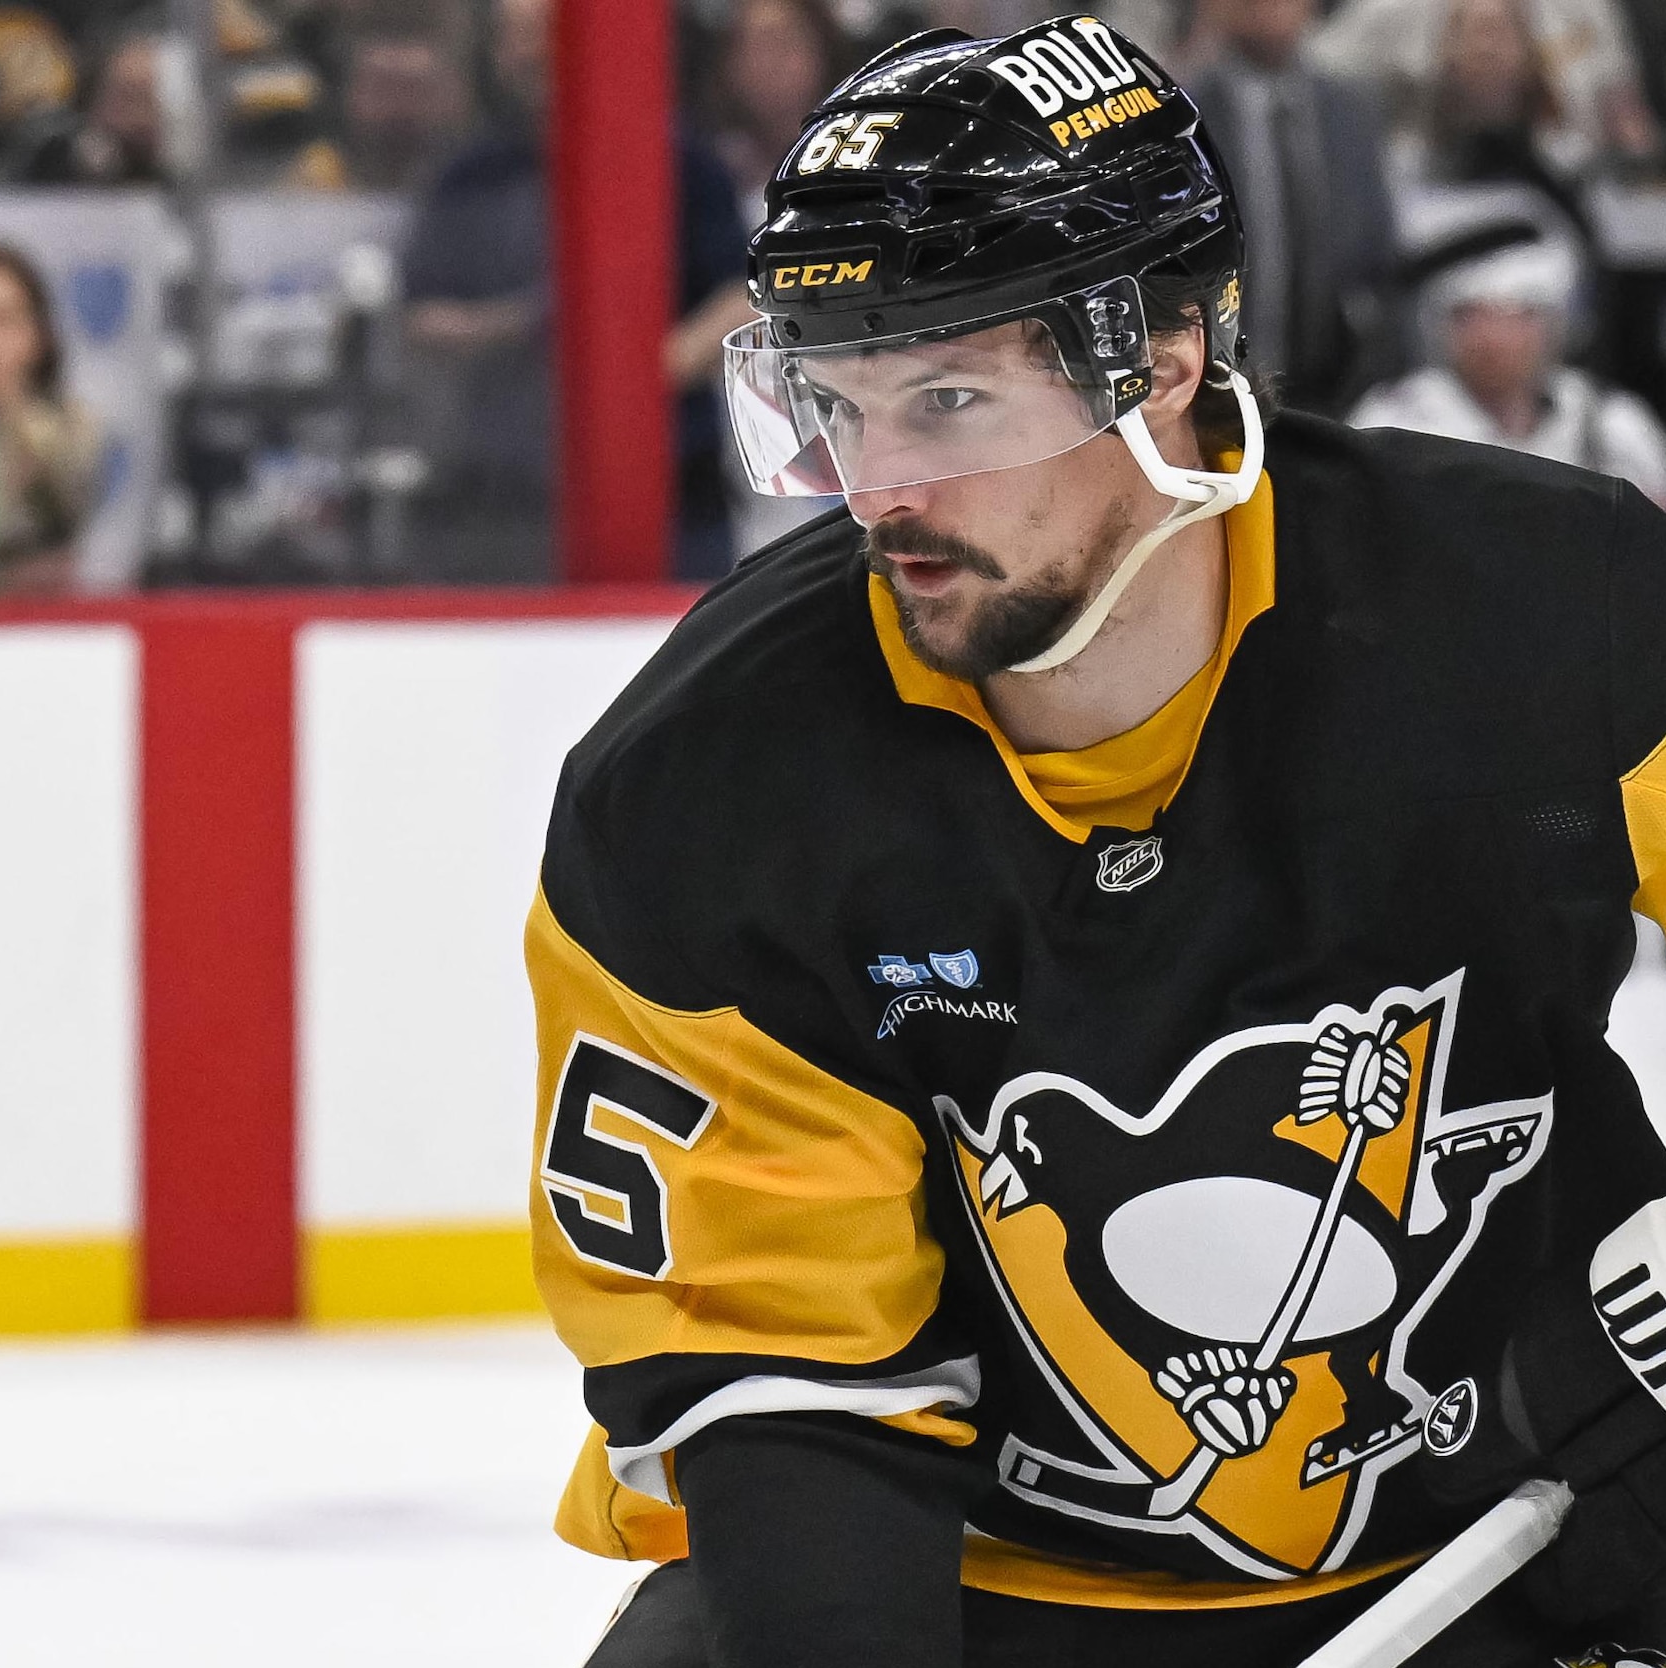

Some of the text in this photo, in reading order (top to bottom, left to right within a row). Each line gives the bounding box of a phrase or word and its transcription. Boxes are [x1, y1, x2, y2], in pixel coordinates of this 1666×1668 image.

[986, 17, 1137, 119] BOLD
[1048, 86, 1163, 148] PENGUIN
[797, 112, 905, 176] 65
[773, 259, 875, 290] CCM
[1117, 385, 1150, 401] OAKLEY
[1110, 848, 1149, 882] NHL
[879, 990, 1019, 1038] HIGHMARK
